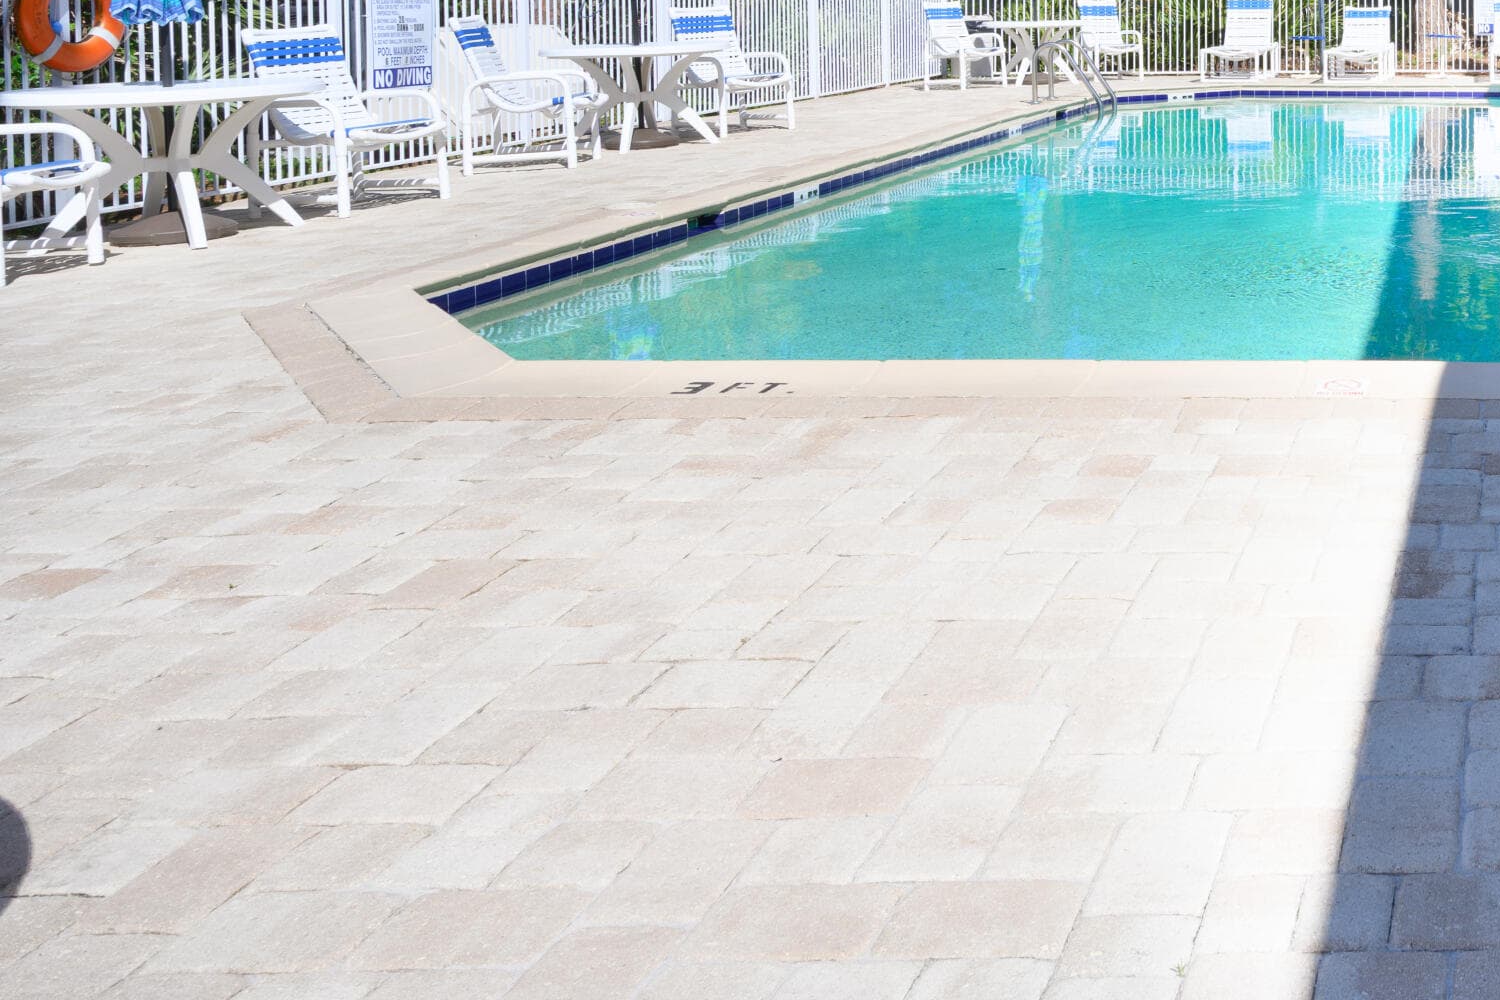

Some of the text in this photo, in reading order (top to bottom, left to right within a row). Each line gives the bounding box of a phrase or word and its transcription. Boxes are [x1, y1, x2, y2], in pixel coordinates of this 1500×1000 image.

[414, 24, 424, 32] DUSK
[1478, 24, 1490, 33] NO
[377, 47, 392, 57] POOL
[393, 46, 413, 56] MAXIMUM
[391, 56, 401, 66] FEET
[410, 55, 425, 65] INCHES
[375, 67, 432, 89] NO DIVING
[670, 381, 715, 395] 3
